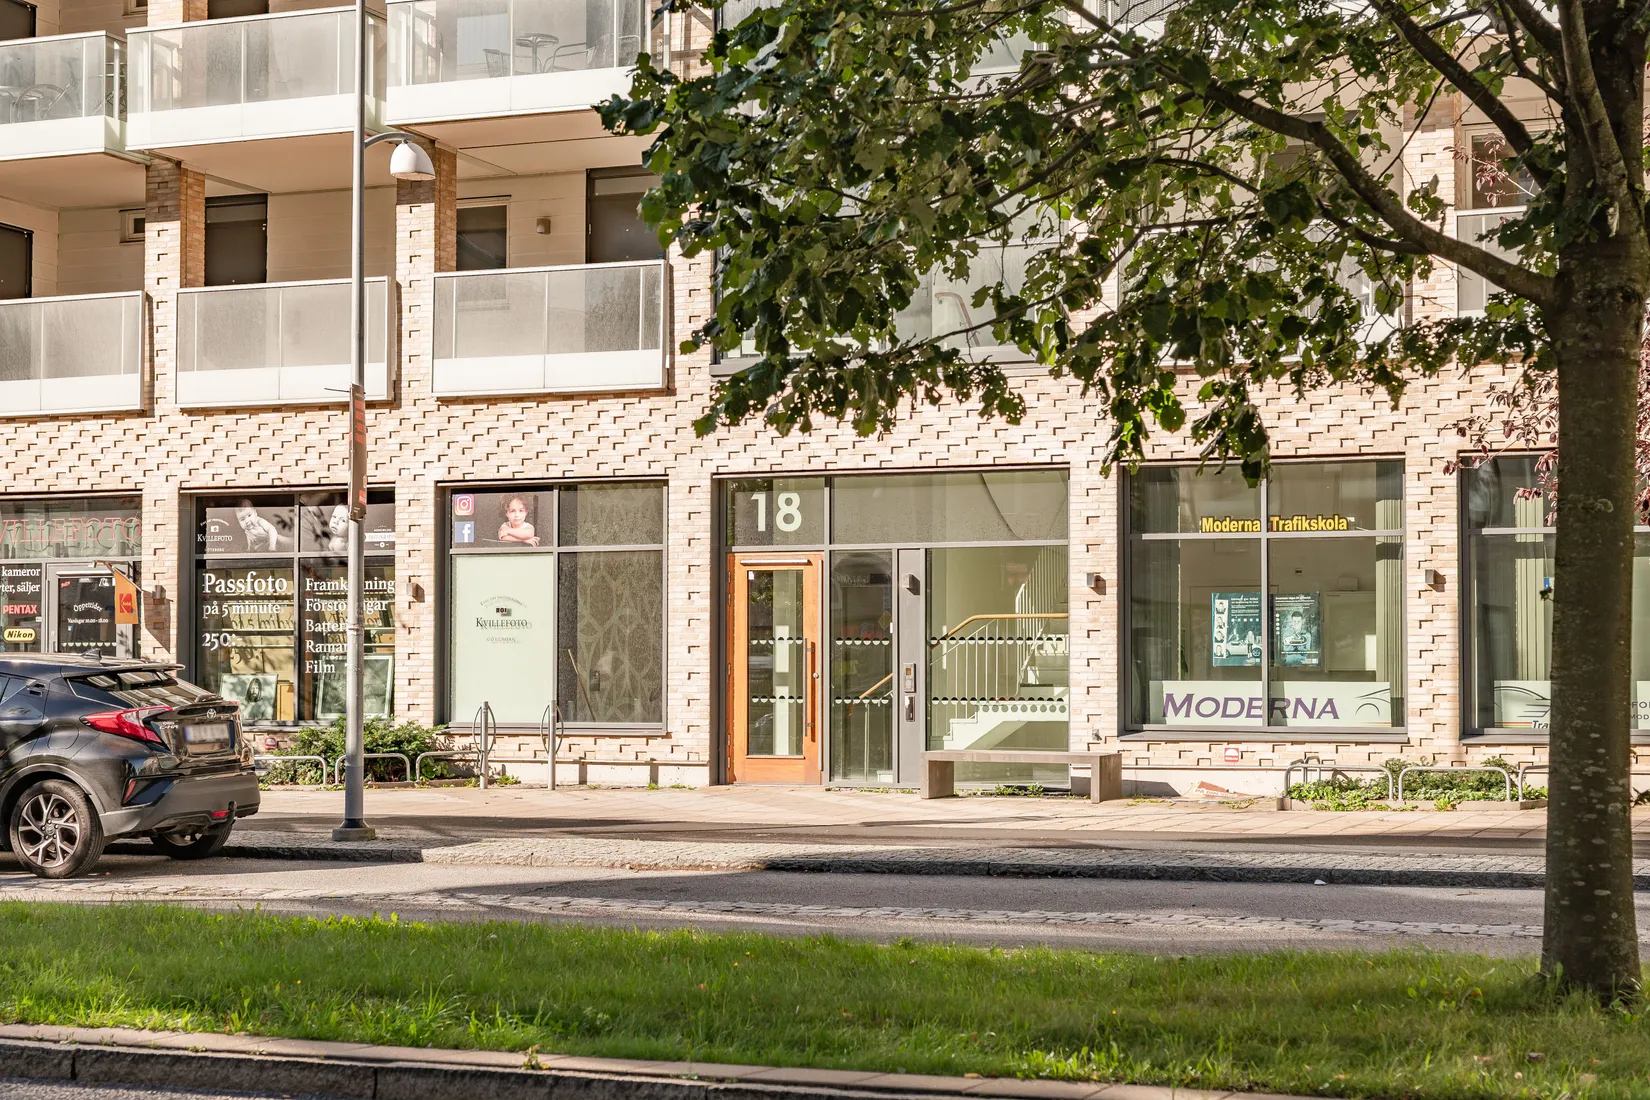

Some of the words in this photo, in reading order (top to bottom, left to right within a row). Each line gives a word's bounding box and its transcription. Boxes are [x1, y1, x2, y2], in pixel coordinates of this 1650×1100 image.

[751, 492, 802, 532] 18
[1201, 516, 1261, 533] Moderna
[1269, 514, 1348, 531] Trafikskola
[2, 566, 41, 576] kameror
[17, 581, 41, 595] säljer
[202, 571, 287, 593] Passfoto
[305, 577, 395, 593] Framkning
[2, 604, 38, 615] PENTAX
[202, 600, 219, 619] på
[221, 604, 228, 617] 5
[305, 598, 388, 614] Förstogar
[305, 619, 348, 633] Batter
[476, 618, 527, 627] KVILLEFOTO
[7, 630, 33, 639] Nikon
[305, 660, 335, 673] Film
[1162, 693, 1340, 719] MODERNA
